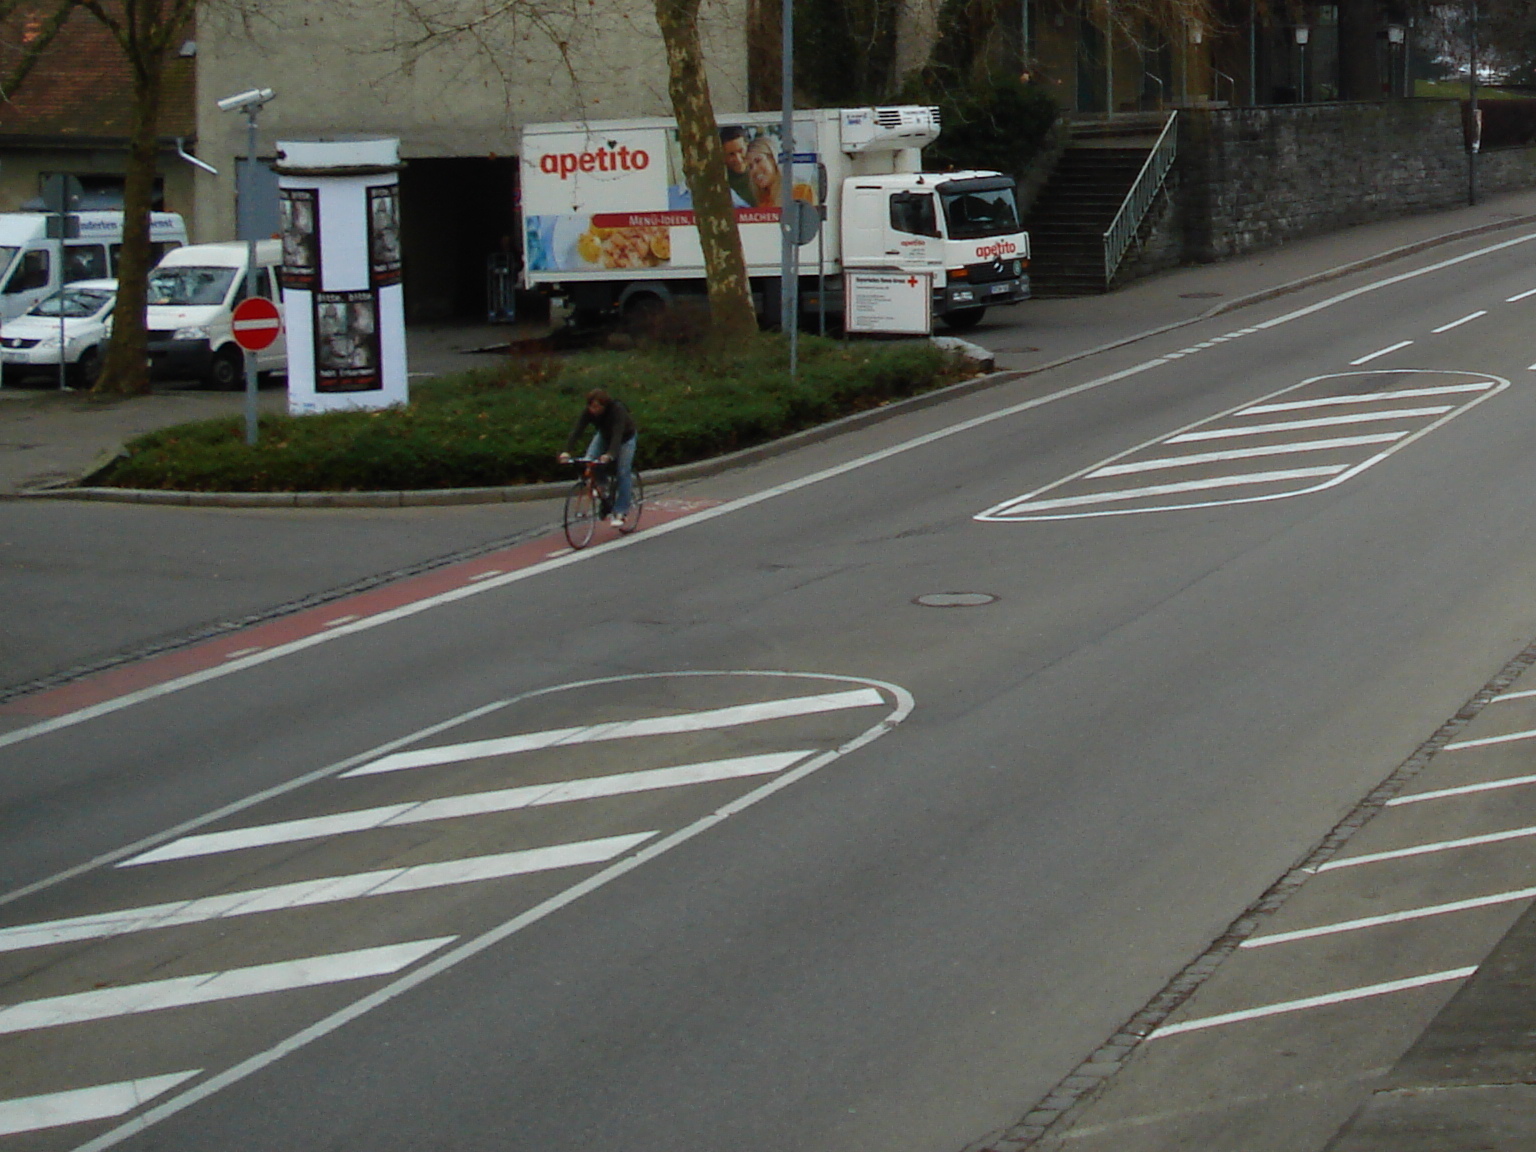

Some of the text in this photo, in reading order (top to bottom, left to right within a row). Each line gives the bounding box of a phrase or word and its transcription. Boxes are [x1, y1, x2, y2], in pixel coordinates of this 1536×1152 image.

[540, 145, 650, 180] apetito
[739, 212, 779, 222] MACHEN
[976, 241, 1017, 260] apetito
